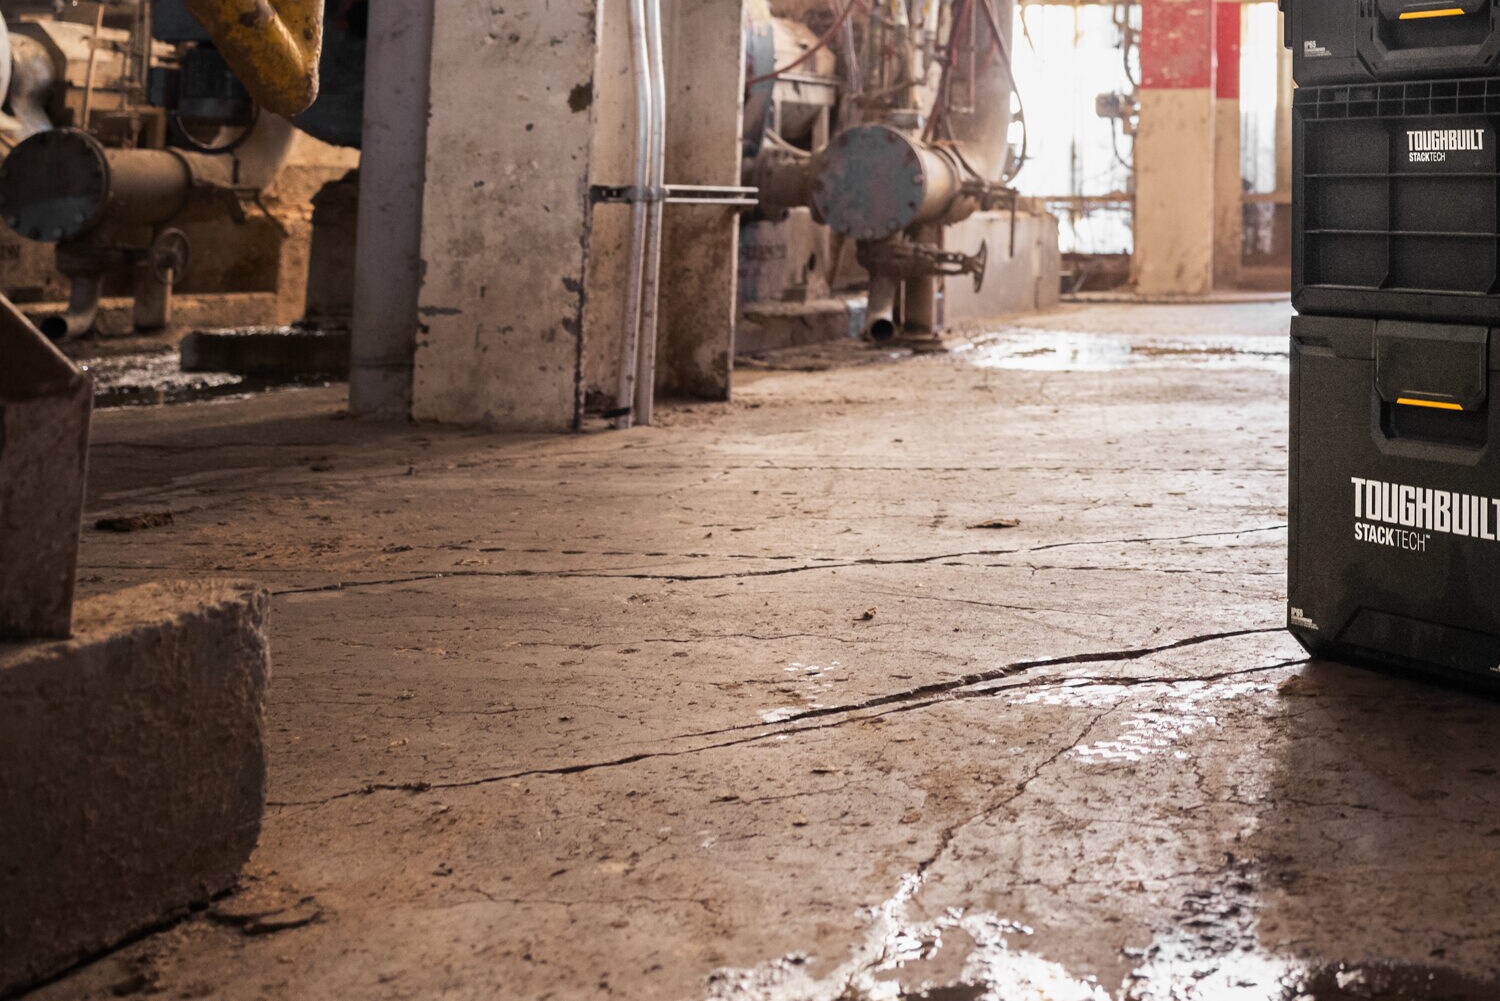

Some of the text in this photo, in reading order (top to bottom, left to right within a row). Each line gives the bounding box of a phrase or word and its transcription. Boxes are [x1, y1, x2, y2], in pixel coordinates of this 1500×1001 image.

[1407, 129, 1484, 151] TOUGHBUILT
[1409, 151, 1446, 162] STACKTECH
[1354, 521, 1430, 552] STACKTECH
